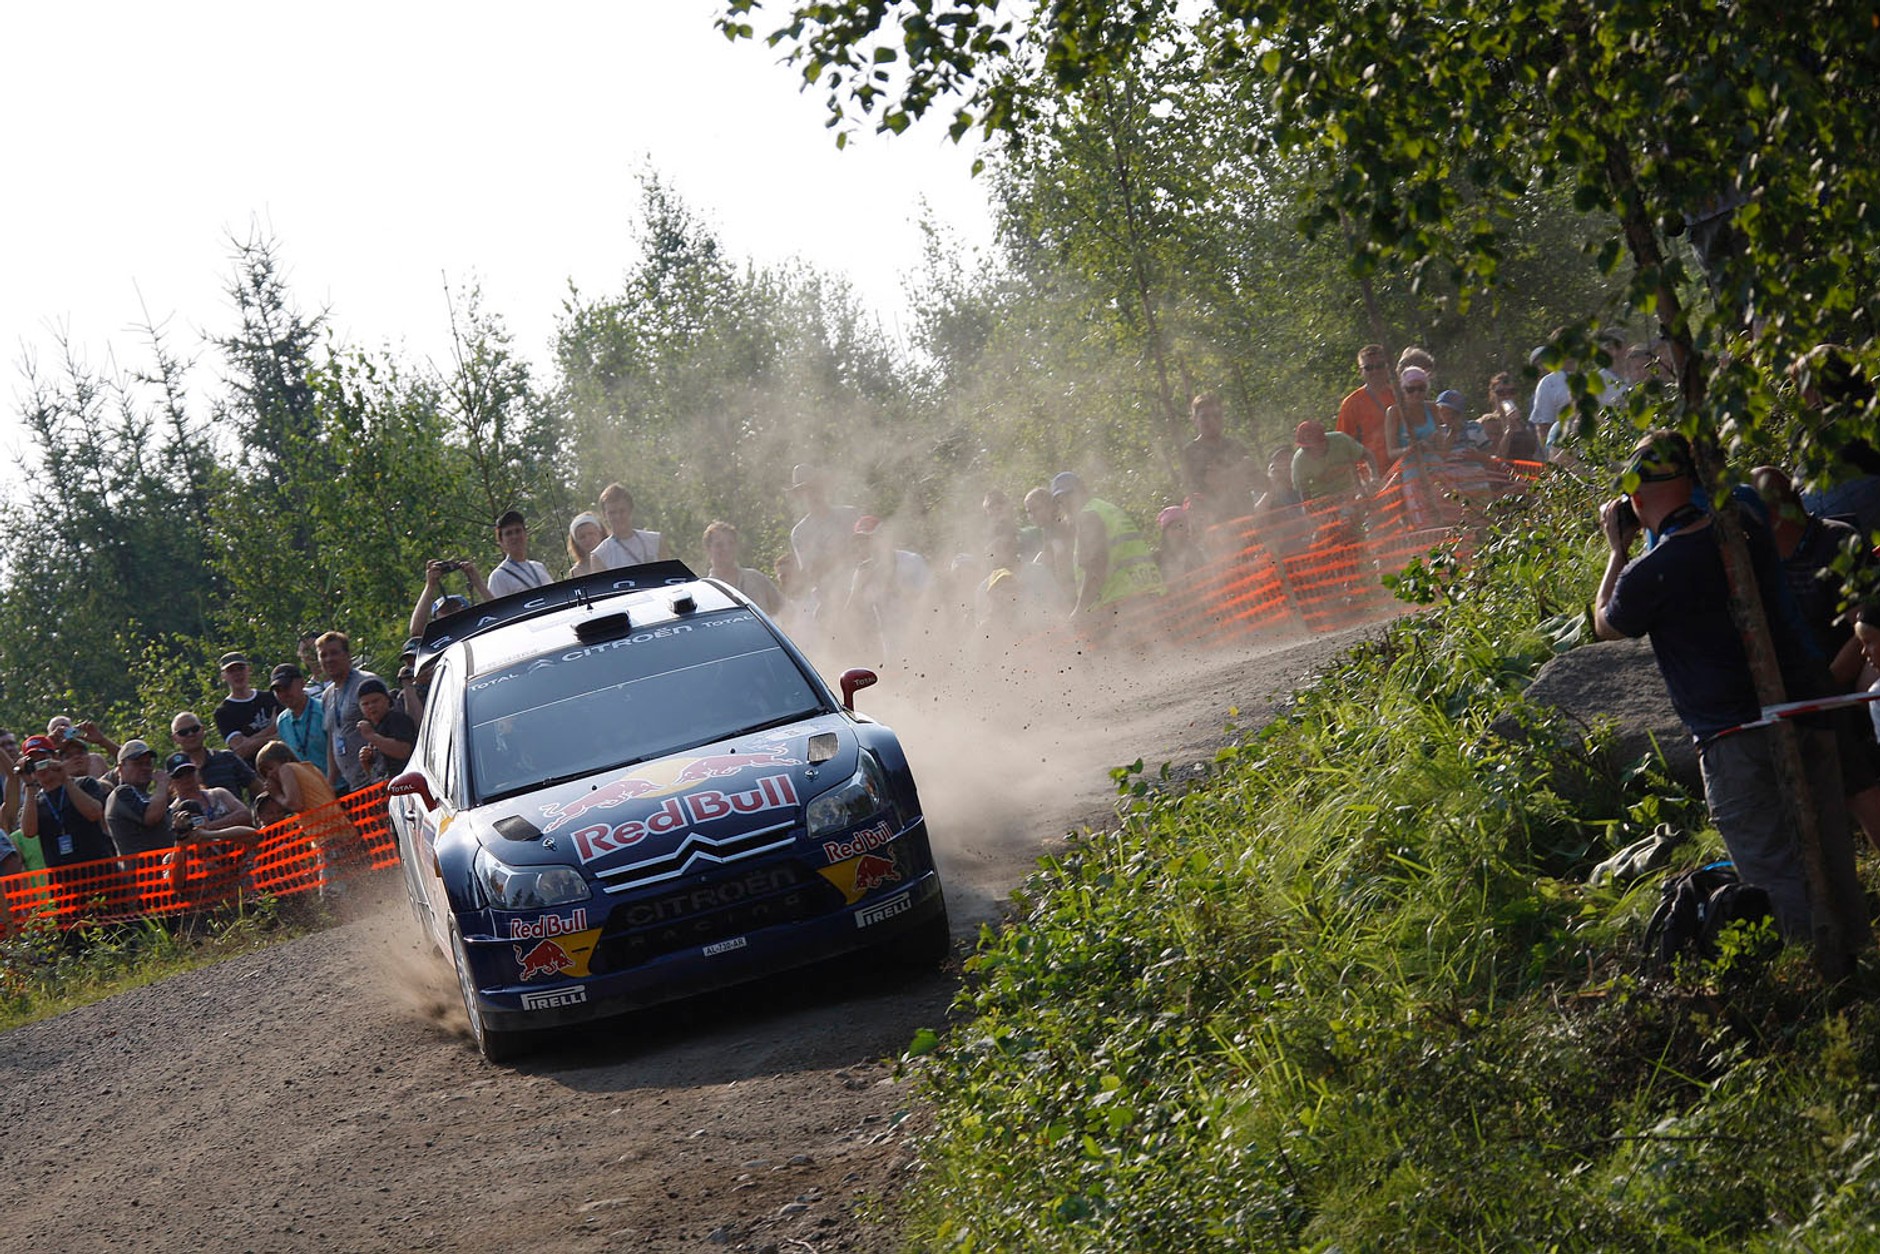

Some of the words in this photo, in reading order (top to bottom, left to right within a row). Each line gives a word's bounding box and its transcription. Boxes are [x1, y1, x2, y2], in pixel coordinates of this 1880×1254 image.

[469, 672, 520, 692] TOTAL
[561, 623, 693, 663] CITROËN
[701, 615, 754, 628] TOTAL
[391, 784, 416, 793] TOTAL
[571, 797, 688, 865] Red
[684, 774, 801, 824] Bull
[823, 832, 866, 863] Red
[861, 821, 894, 849] Bull
[510, 914, 545, 939] Red
[546, 908, 588, 937] Bull
[854, 892, 912, 928] PIRELLI
[520, 985, 587, 1011] PIRELLI
